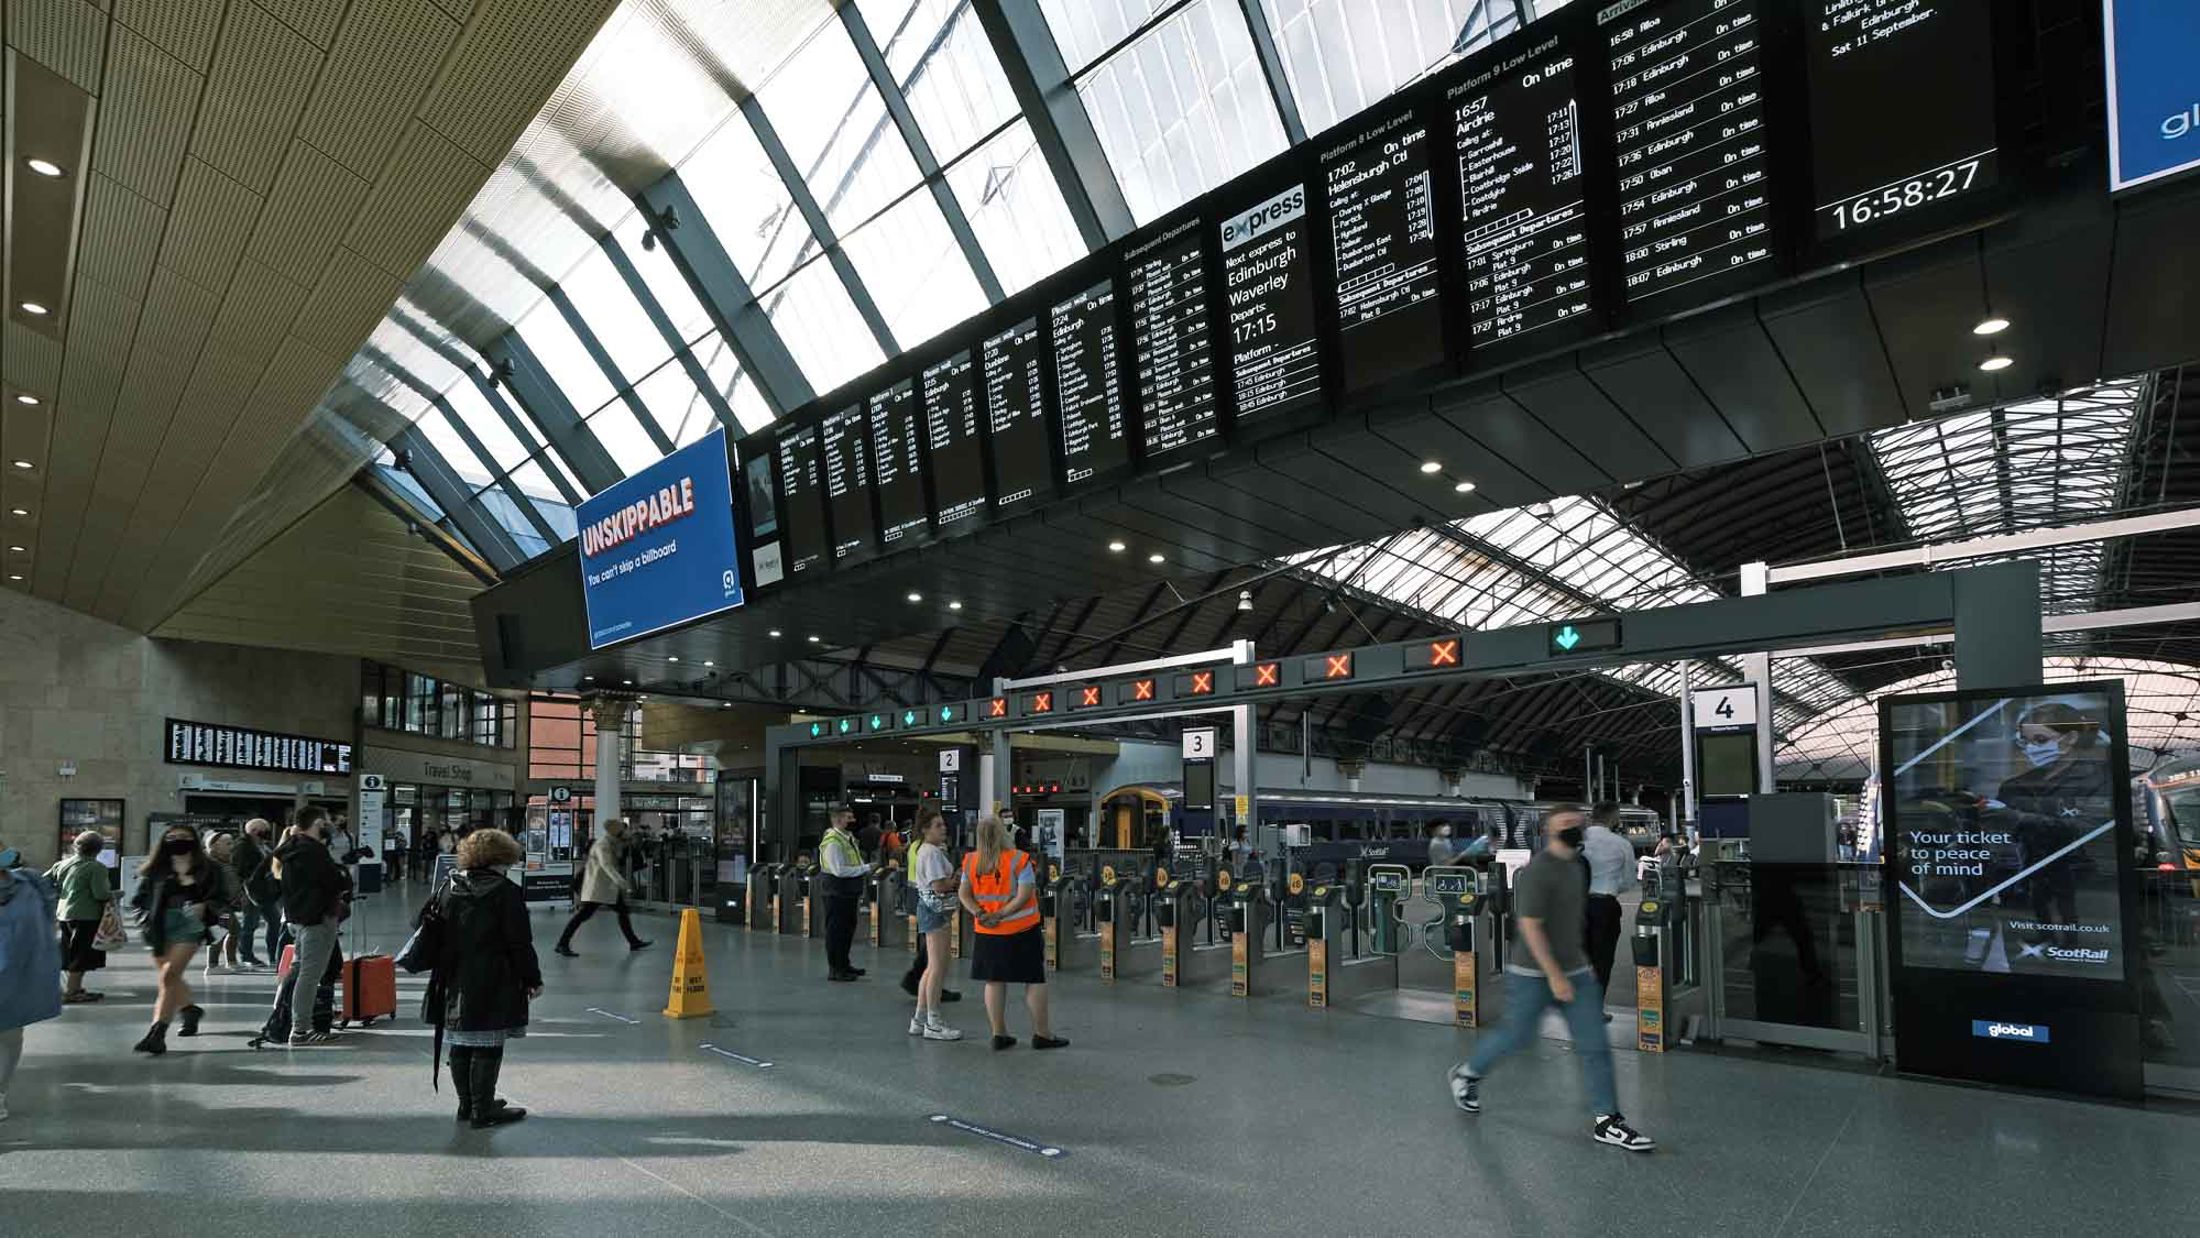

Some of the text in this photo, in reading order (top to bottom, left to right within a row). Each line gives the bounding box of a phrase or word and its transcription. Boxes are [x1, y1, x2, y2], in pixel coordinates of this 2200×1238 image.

[1716, 13, 1752, 35] On time
[1821, 22, 1829, 31] &
[1833, 3, 1872, 27] Falkirk
[1861, 0, 1919, 30] Edinburgh
[1610, 28, 1634, 47] 16:58
[1641, 29, 1687, 57] Edinburgh
[1831, 8, 1938, 57] Sat 11 September.
[1717, 40, 1754, 61] On time
[1447, 35, 1558, 100] Platform 9 Low Level
[1642, 54, 1689, 82] Edinburgh
[1719, 66, 1755, 87] On time
[1455, 58, 1573, 122] 16:57 On time
[1720, 92, 1757, 112] On time
[1456, 111, 1495, 136] Airdrie
[1722, 118, 1758, 138] On time
[1320, 140, 1357, 164] Platform
[1366, 125, 1386, 140] Low
[1386, 109, 1413, 130] Level
[1456, 135, 1480, 150] Calling
[1647, 130, 1694, 155] Edinburgh
[1328, 129, 1426, 183] 17:02 On time
[1468, 145, 1517, 171] Easterhouse
[1724, 145, 1760, 164] On time
[1328, 160, 1390, 196] Helensburgh
[1470, 172, 1511, 195] Coatbridge
[1726, 170, 1762, 189] On time
[1651, 180, 1698, 204] Edinburgh
[1833, 160, 1979, 229] 16:58:27
[1223, 191, 1304, 242] express
[1727, 196, 1763, 214] On time
[1466, 208, 1574, 255] Subsequent Departures
[1729, 222, 1765, 240] On time
[1225, 231, 1296, 269] Next express to
[1491, 240, 1534, 261] Springburn
[1552, 239, 1564, 249] On
[1228, 245, 1296, 287] Edinburgh
[1554, 262, 1565, 272] On
[1656, 255, 1702, 278] Edinburgh
[1730, 248, 1767, 265] On time
[1493, 262, 1531, 287] Edinburgh
[1229, 272, 1288, 307] Waverley
[1495, 285, 1533, 309] Edinburgh
[1556, 285, 1567, 295] On
[1557, 308, 1569, 318] On
[1233, 313, 1276, 344] 17:15
[1234, 344, 1272, 365] Platform
[582, 477, 694, 557] UNSKIPPABLE
[588, 539, 677, 587] You can't skip a billboard
[1715, 696, 1734, 719] 4
[1193, 735, 1202, 752] 3
[946, 753, 953, 767] 2
[1910, 830, 2011, 846] Your ticket
[1911, 847, 1991, 863] to peace
[1911, 862, 1983, 876] of mind
[2010, 921, 2110, 933] Visit scotrail.co.uk
[2047, 946, 2109, 960] ScotRail
[1987, 1022, 2033, 1038] global
